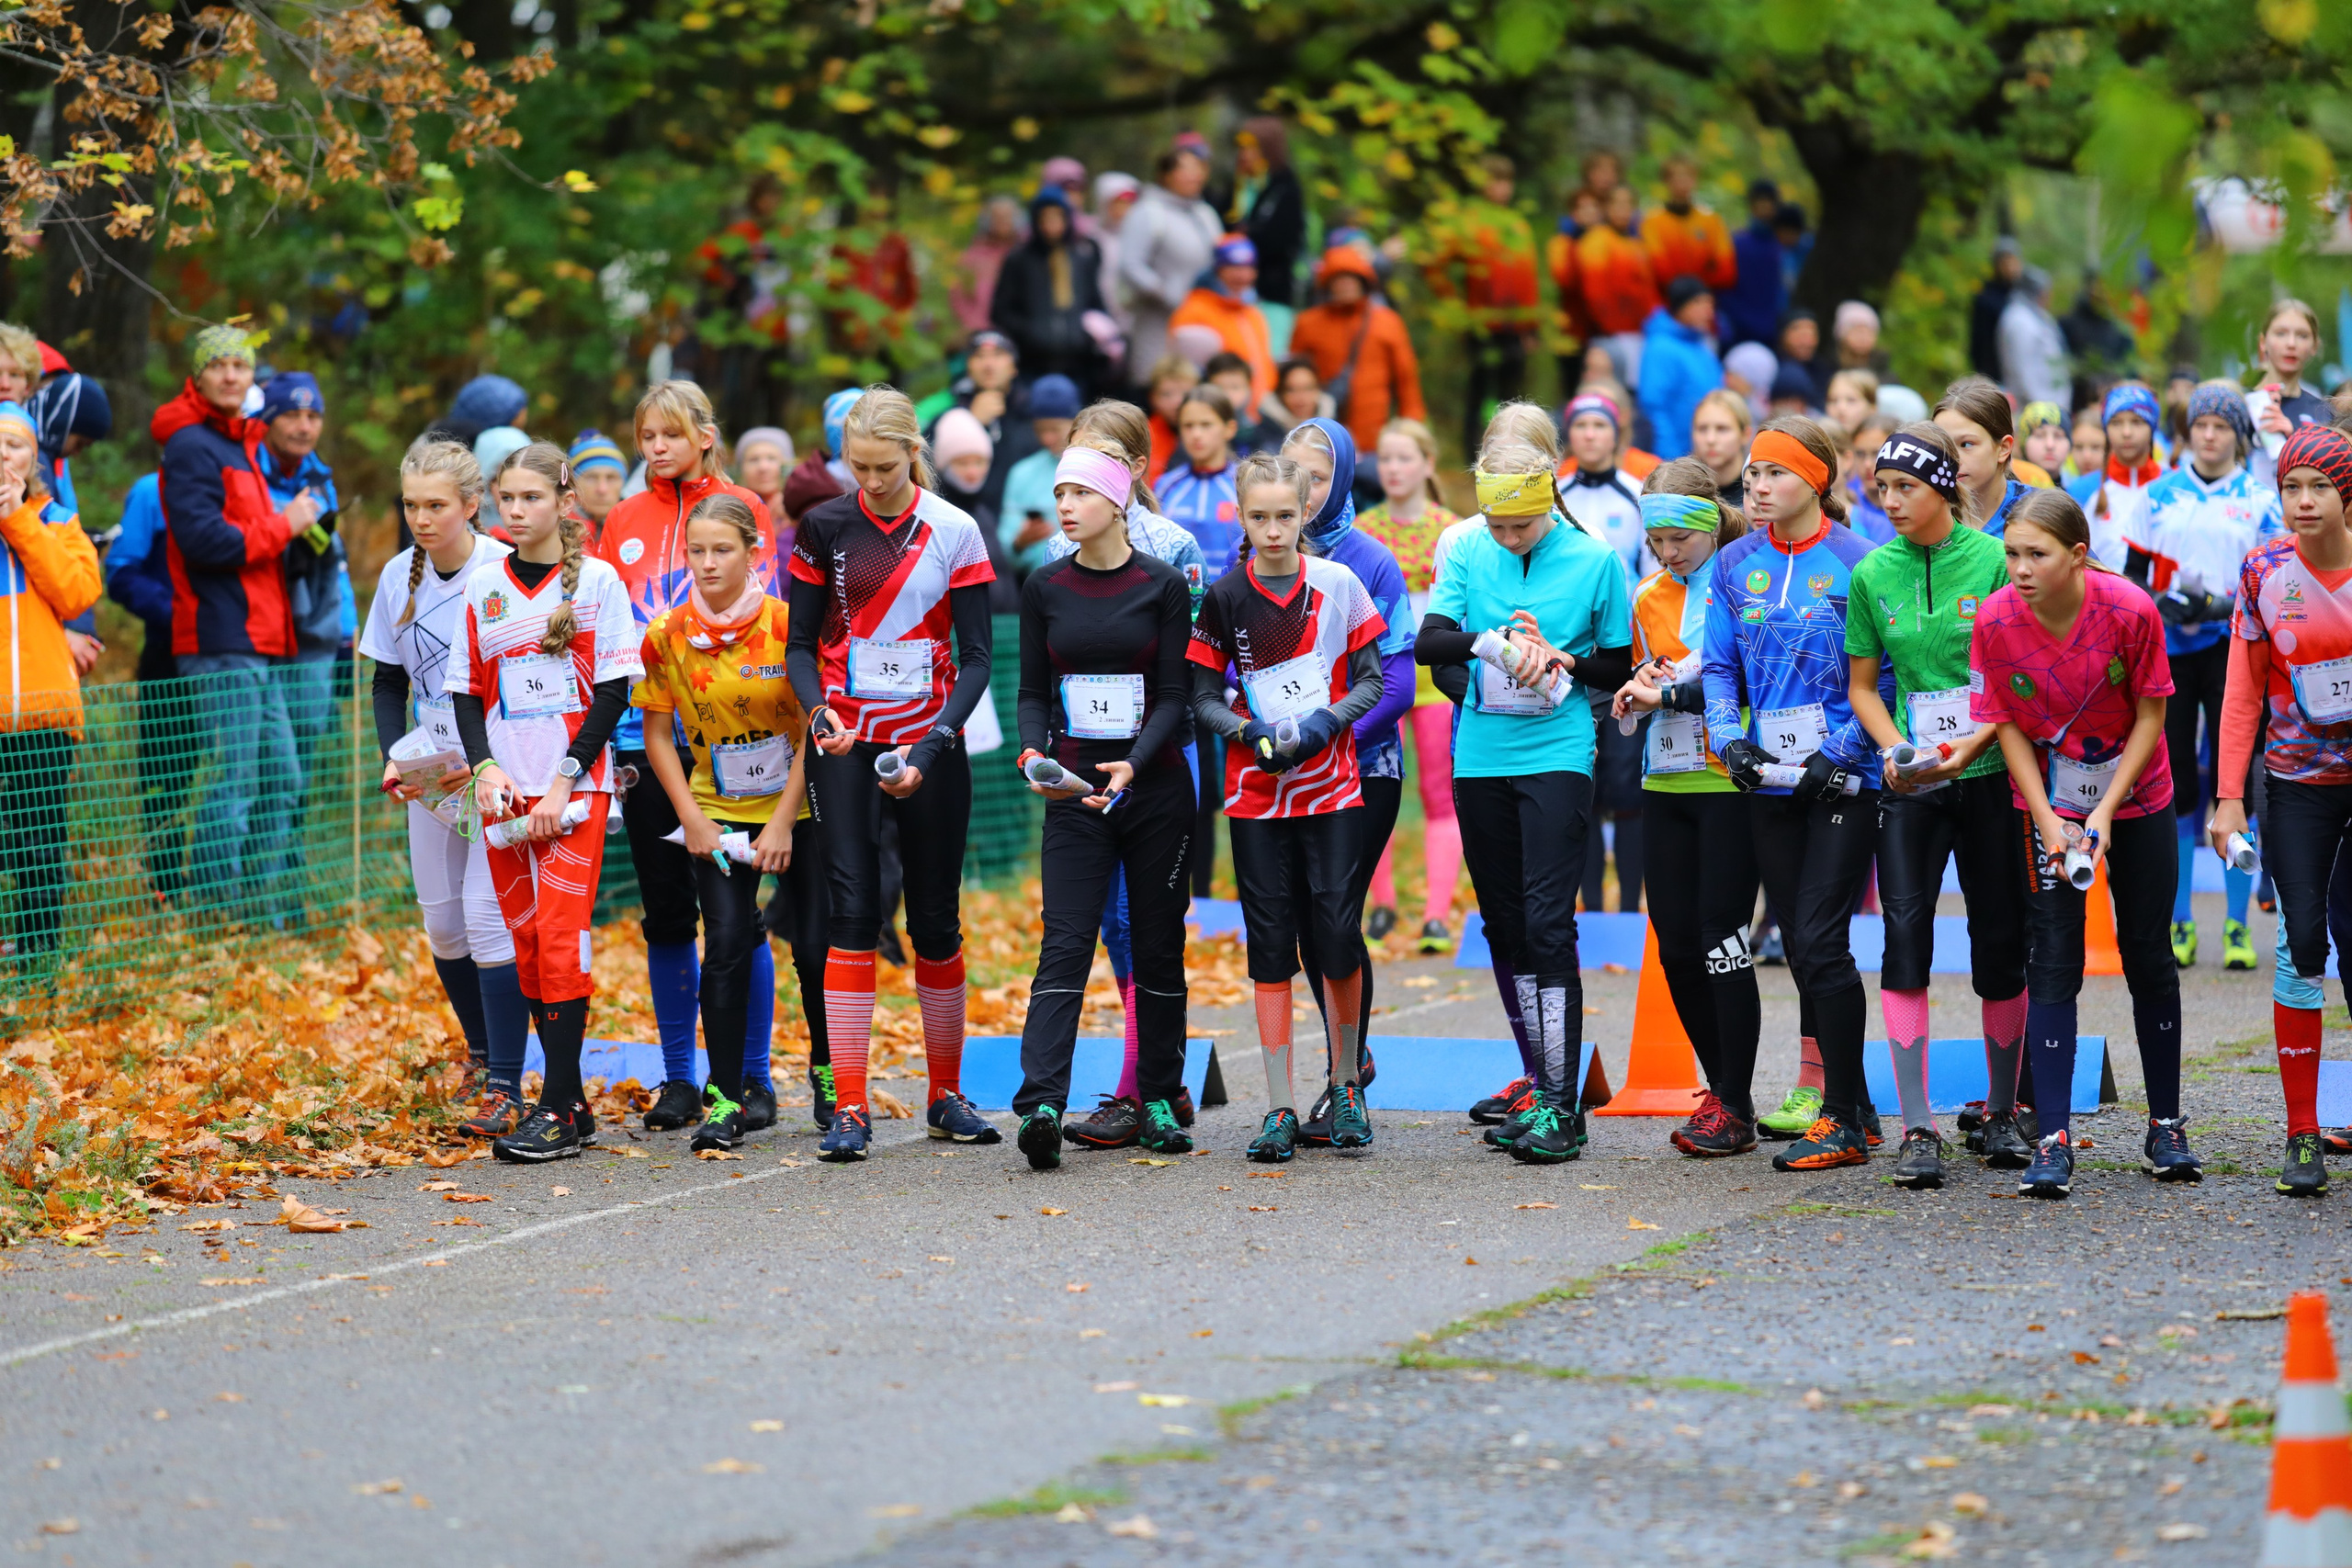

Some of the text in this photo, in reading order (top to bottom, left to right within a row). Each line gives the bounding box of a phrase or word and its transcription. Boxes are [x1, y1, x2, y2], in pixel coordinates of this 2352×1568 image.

[879, 662, 899, 677] 35
[525, 676, 543, 694] 36
[1282, 681, 1301, 700] 33
[2331, 681, 2350, 696] 27
[1090, 700, 1108, 715] 34
[434, 723, 448, 736] 48
[1937, 716, 1957, 731] 28
[1660, 737, 1673, 752] 30
[1779, 733, 1796, 749] 29
[746, 762, 764, 777] 46
[2077, 784, 2098, 796] 40
[2024, 836, 2039, 893] спортивное
